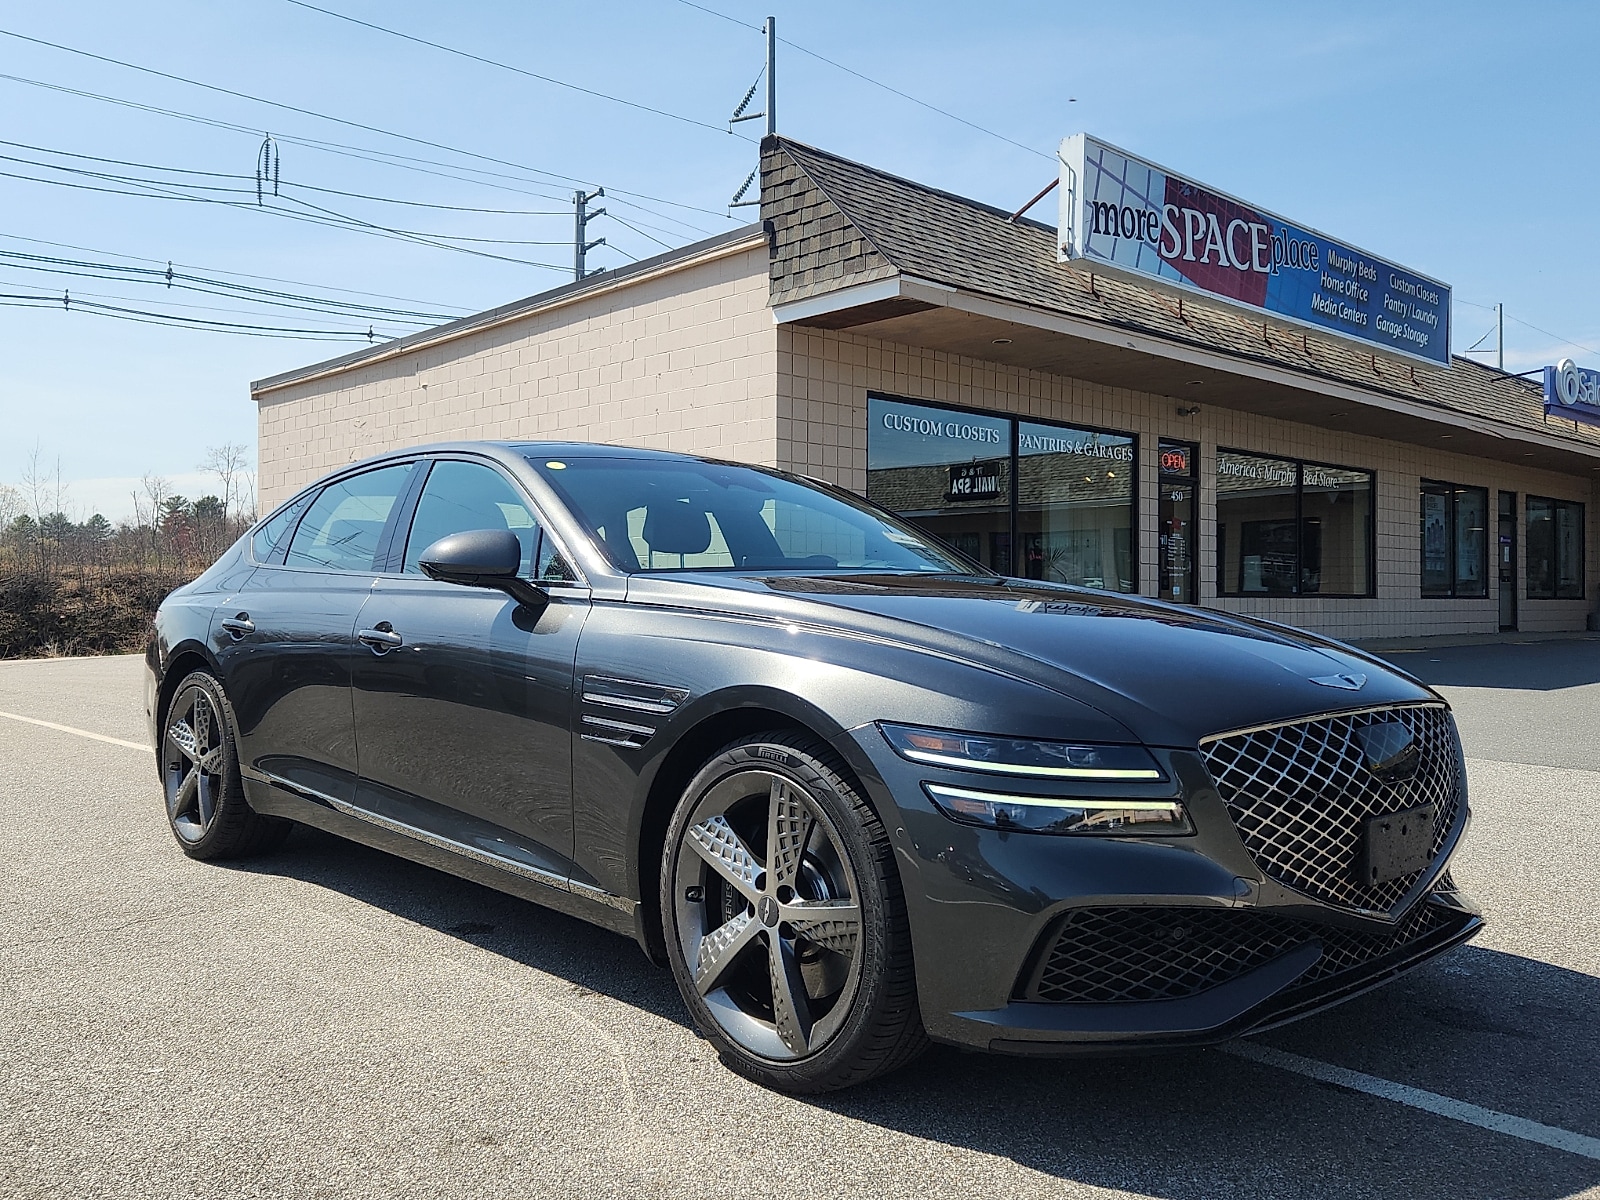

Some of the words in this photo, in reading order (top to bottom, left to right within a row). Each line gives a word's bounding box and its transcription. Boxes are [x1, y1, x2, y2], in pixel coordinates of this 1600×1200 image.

[1327, 249, 1357, 277] Murphy
[1359, 261, 1377, 281] Beds
[1321, 271, 1344, 293] Home
[1345, 280, 1368, 301] Office
[1389, 273, 1415, 296] Custom
[1416, 284, 1439, 305] Closets
[1311, 293, 1337, 316] Media
[1338, 302, 1367, 325] Centers
[1384, 293, 1408, 319] Pantry
[1412, 304, 1439, 329] Laundry
[1376, 315, 1403, 339] Garage
[1403, 323, 1429, 347] Storage
[883, 413, 942, 437] CUSTOM
[945, 422, 1000, 444] CLOSETS
[1019, 433, 1073, 453] PANTRIES
[1074, 440, 1083, 454] &
[1084, 443, 1133, 461] GARAGES
[1161, 453, 1185, 470] OPEN
[1219, 458, 1262, 479] America's
[1263, 465, 1297, 487] Murphy
[1303, 469, 1318, 486] Bed
[1170, 490, 1184, 502] 450
[757, 746, 789, 764] PIRELLI
